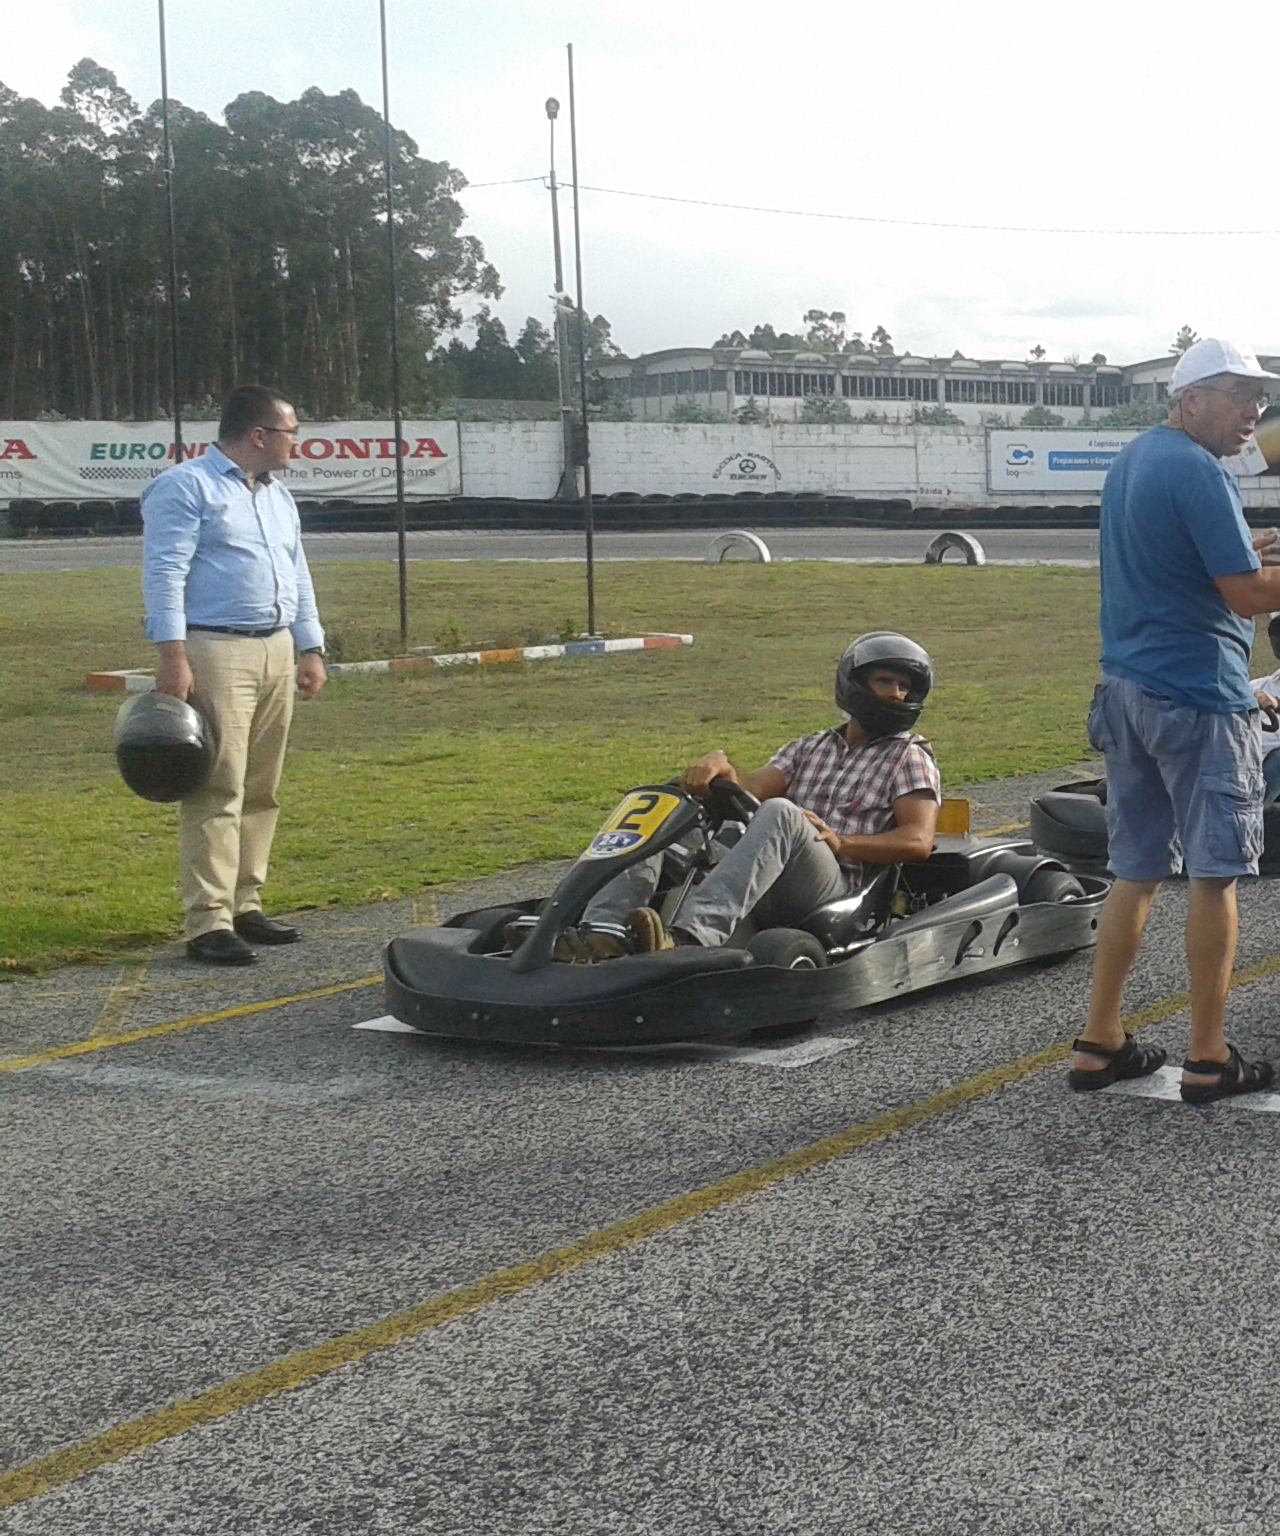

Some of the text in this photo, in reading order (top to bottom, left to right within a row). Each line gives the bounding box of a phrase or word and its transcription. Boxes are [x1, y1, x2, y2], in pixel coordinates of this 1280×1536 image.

[312, 467, 357, 479] Power
[362, 466, 376, 478] of
[381, 466, 437, 478] Drams
[615, 794, 660, 831] 2
